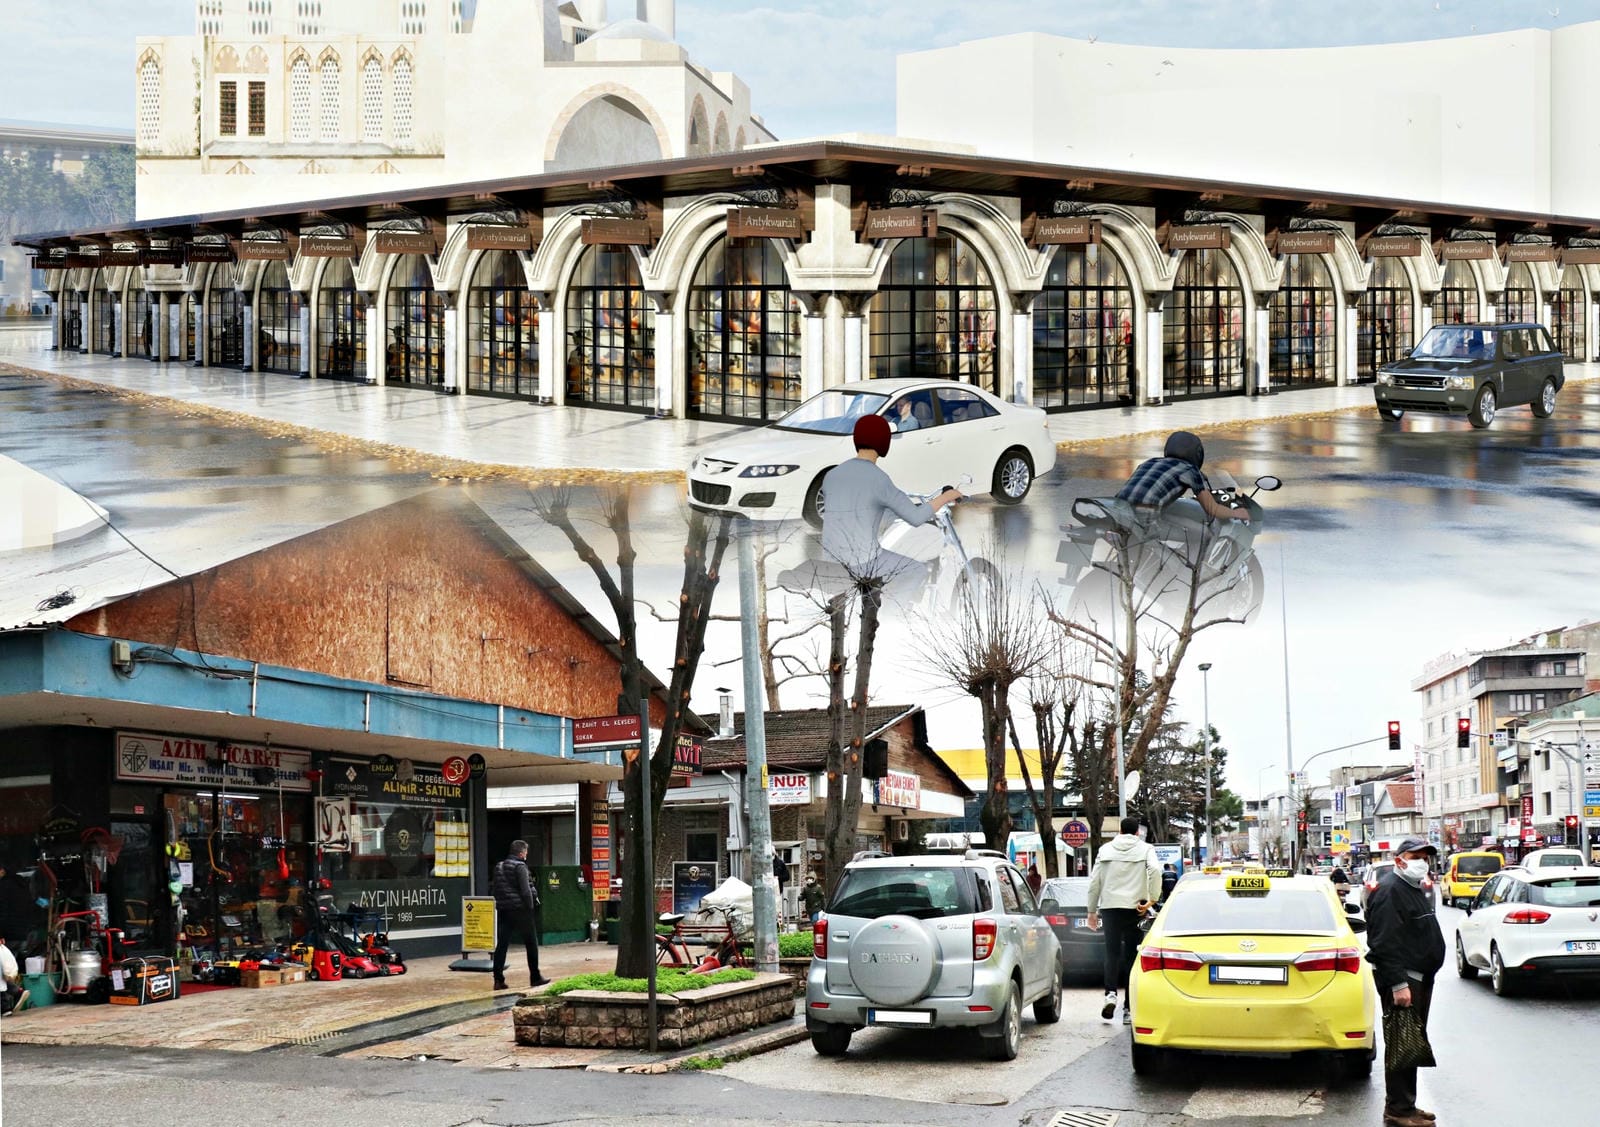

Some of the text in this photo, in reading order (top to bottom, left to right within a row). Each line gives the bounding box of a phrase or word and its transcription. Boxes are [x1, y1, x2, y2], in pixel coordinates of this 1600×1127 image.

[745, 216, 796, 230] Antykwariat
[870, 215, 916, 231] Antykwariat
[1039, 225, 1084, 239] Antykwariat
[1172, 233, 1216, 245] Antykwariat
[1280, 239, 1322, 250] Antykwariat
[310, 242, 352, 253] Antykwariat
[1370, 242, 1410, 253] Antykwariat
[160, 740, 282, 768] AZİM TİCARET
[371, 764, 394, 773] EMLAK
[774, 775, 807, 788] NUR
[383, 781, 417, 794] ALINIR
[425, 785, 462, 798] SATILIR
[401, 884, 447, 906] HARİTA
[397, 911, 413, 922] 1969
[1572, 942, 1583, 951] 34
